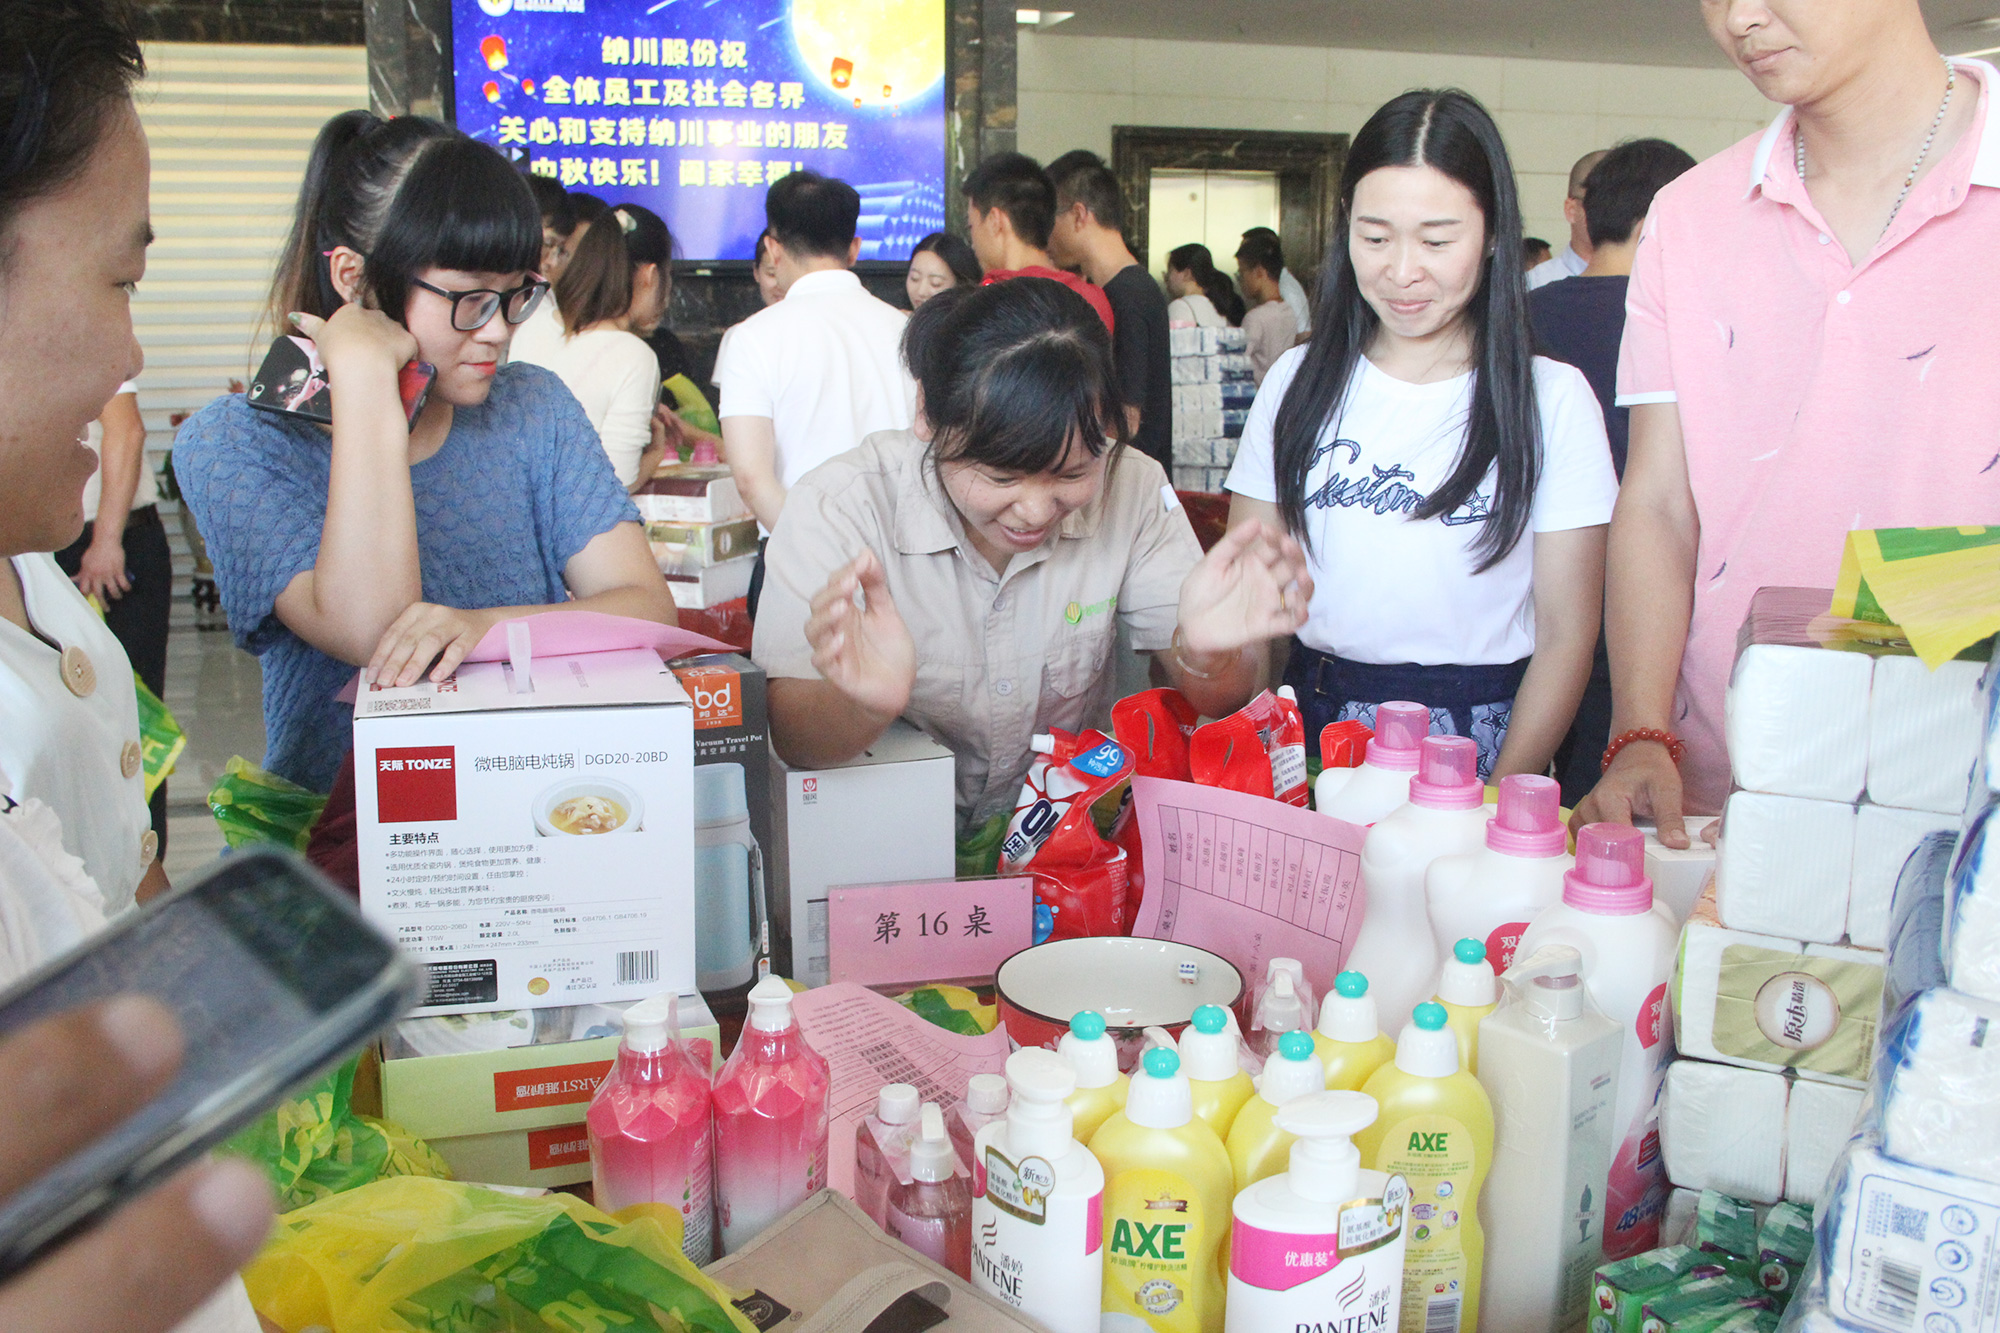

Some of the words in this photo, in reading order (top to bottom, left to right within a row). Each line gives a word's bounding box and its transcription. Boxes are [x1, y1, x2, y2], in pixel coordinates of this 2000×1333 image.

[602, 36, 747, 69] 纳川股份祝
[542, 78, 805, 109] 全体员工及社会各界
[498, 117, 849, 150] 关心和支持纳川事业的朋友
[694, 683, 731, 710] bd
[725, 736, 749, 745] Travel
[750, 734, 763, 742] Pot
[379, 759, 404, 773] 天际
[405, 758, 453, 771] TONZE
[474, 752, 575, 774] 微电脑电炖锅
[585, 751, 669, 766] DGD20-20BD
[1095, 745, 1120, 767] 99
[389, 832, 440, 846] 主要特点
[873, 911, 901, 944] 第
[917, 911, 949, 937] 16
[963, 904, 994, 938] 桌
[1407, 1132, 1448, 1152] AXE
[1110, 1218, 1187, 1260] AXE
[972, 1242, 1024, 1300] ANTENE
[1284, 1251, 1329, 1268] 优惠装
